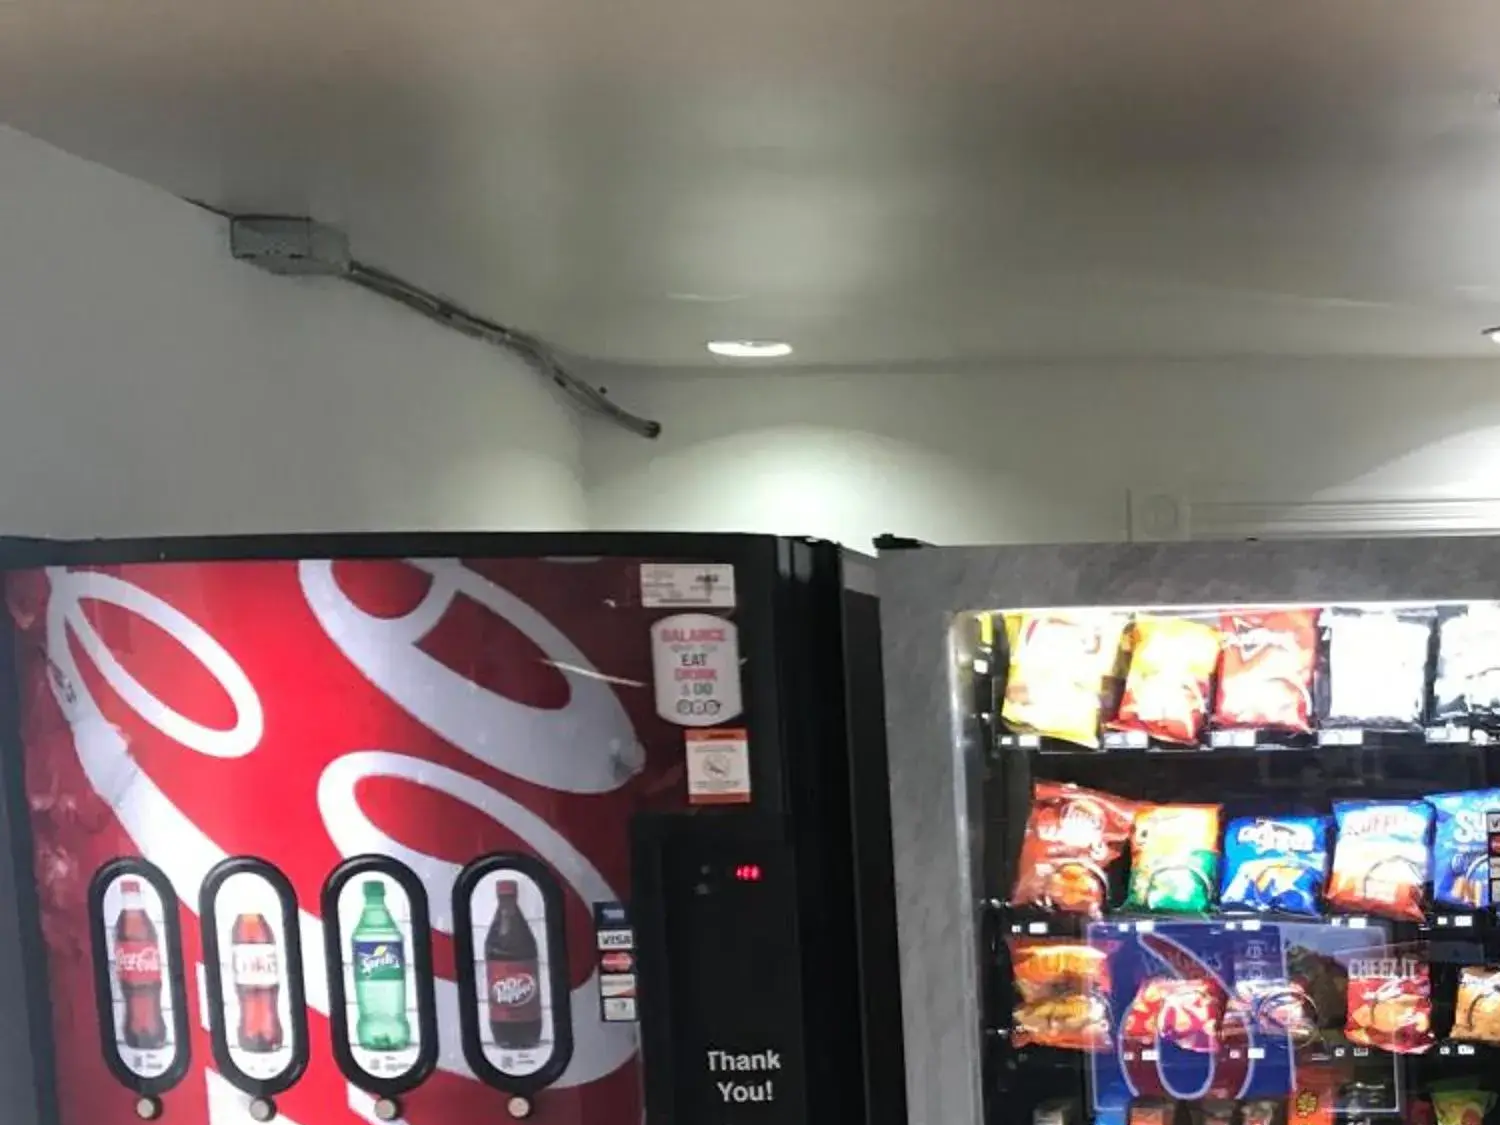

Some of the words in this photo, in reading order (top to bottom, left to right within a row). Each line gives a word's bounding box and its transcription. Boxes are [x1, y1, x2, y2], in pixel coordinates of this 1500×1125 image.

[681, 653, 708, 667] EAT
[601, 933, 632, 946] VISA
[360, 952, 400, 977] Sprite
[706, 1049, 781, 1072] Thank
[717, 1080, 774, 1102] You!
